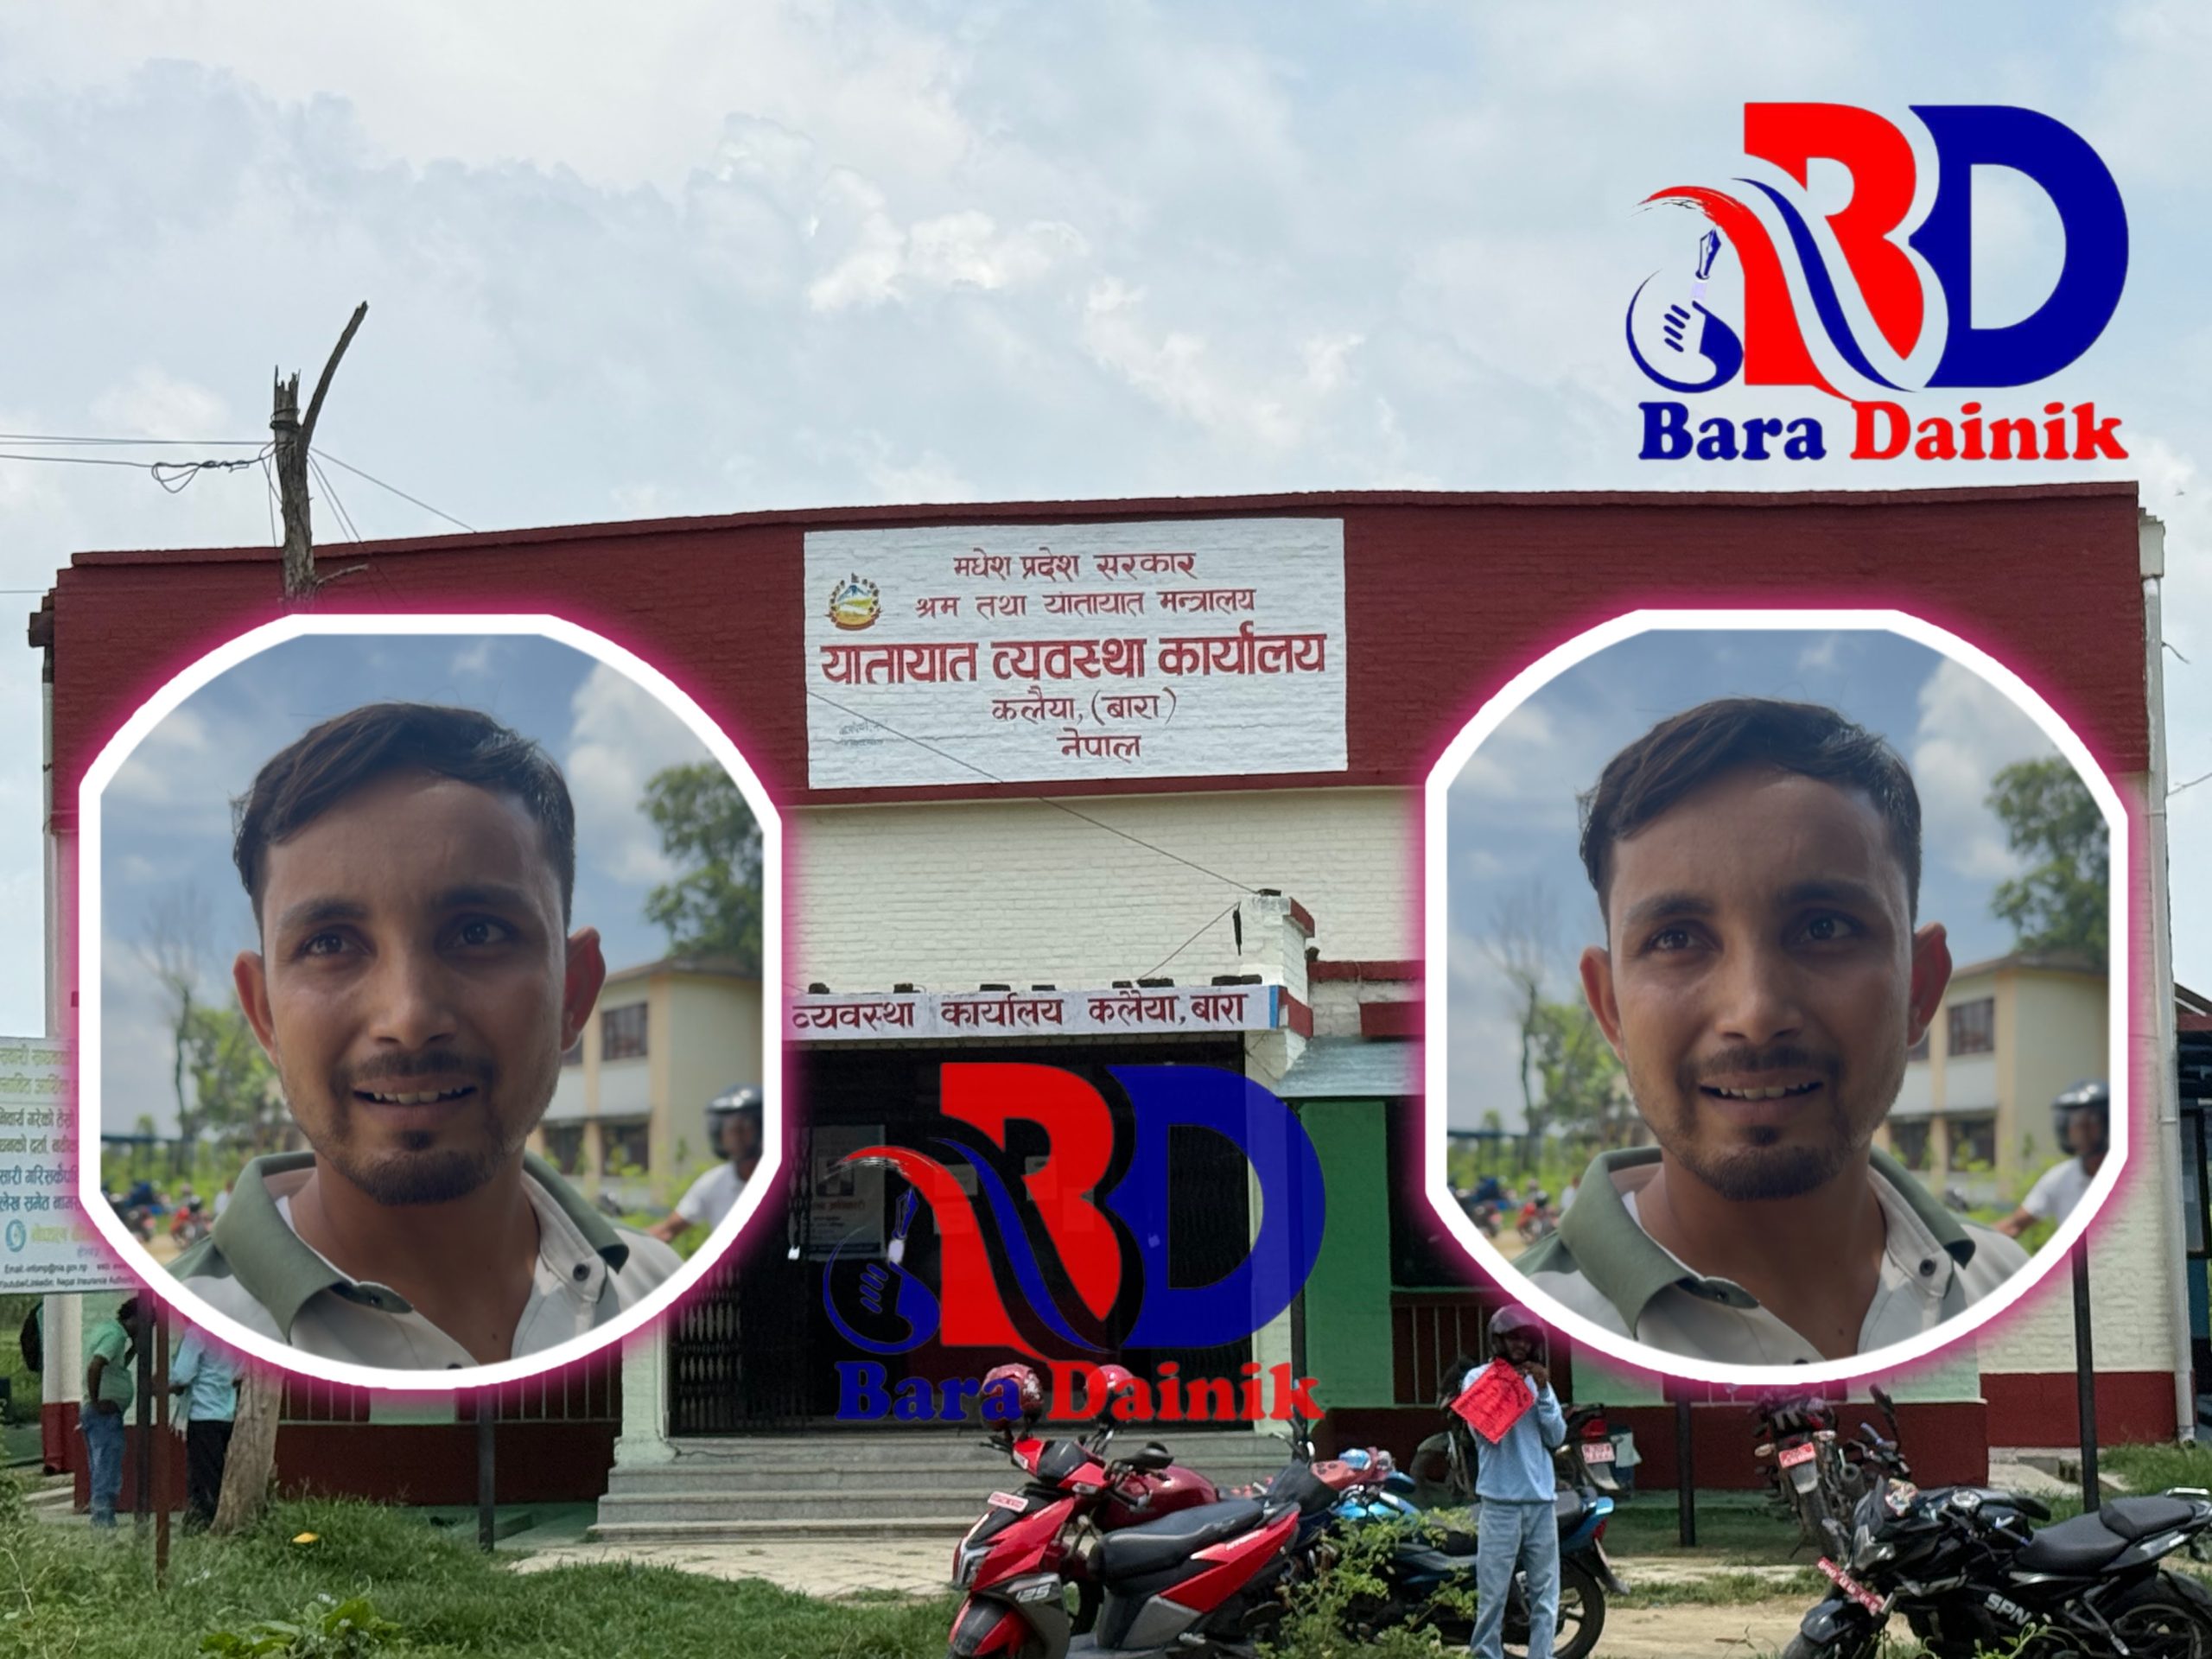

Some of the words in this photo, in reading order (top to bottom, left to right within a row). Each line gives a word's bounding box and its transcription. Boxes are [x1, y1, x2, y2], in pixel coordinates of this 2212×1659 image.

[953, 549, 1011, 577] मधेश
[1020, 547, 1080, 581] प्रदेश
[1093, 551, 1197, 579] सरकार
[914, 596, 960, 619] श्रम
[976, 594, 1027, 617] तथा
[1043, 591, 1145, 615] यातायात
[1158, 588, 1256, 613] मन्त्रालय
[821, 641, 979, 685] यातायात
[990, 637, 1147, 680] व्यवस्था
[1159, 620, 1328, 677] कार्यालय
[1091, 688, 1177, 726] (बारा)
[1057, 728, 1141, 763] नेपाल
[792, 1002, 916, 1030] व्यवस्था
[941, 992, 1065, 1027] कार्यालय
